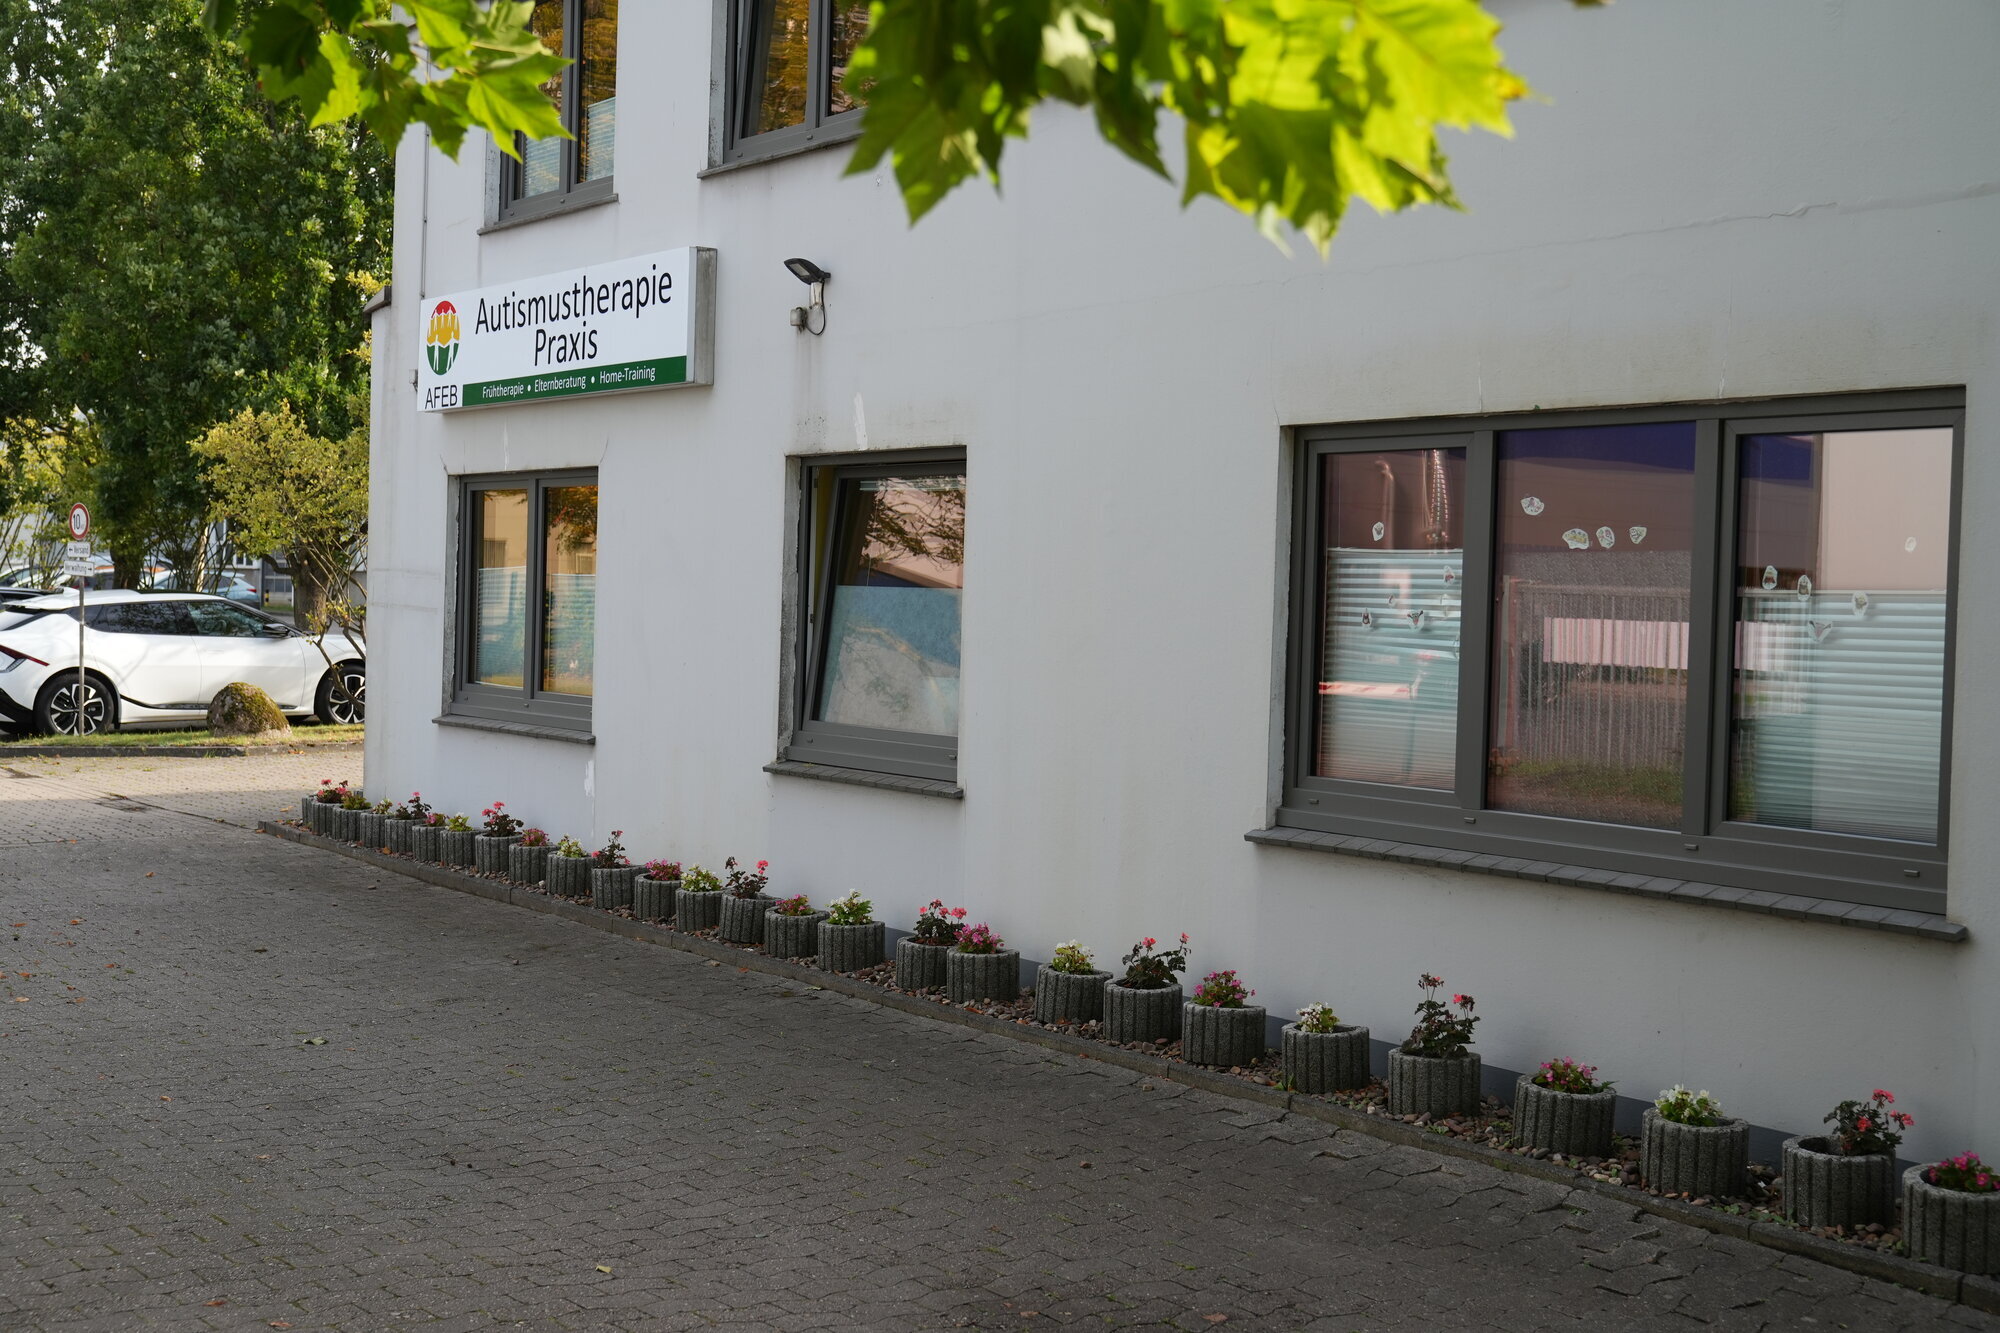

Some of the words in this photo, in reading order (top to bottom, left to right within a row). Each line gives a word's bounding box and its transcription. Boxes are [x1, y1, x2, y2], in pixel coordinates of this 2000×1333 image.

[475, 263, 672, 335] Autismustherapie
[534, 321, 598, 367] Praxis
[424, 384, 458, 410] AFEB
[482, 381, 524, 399] Frühtherapie
[534, 374, 586, 393] Elternberatung
[599, 366, 656, 385] Home-Training
